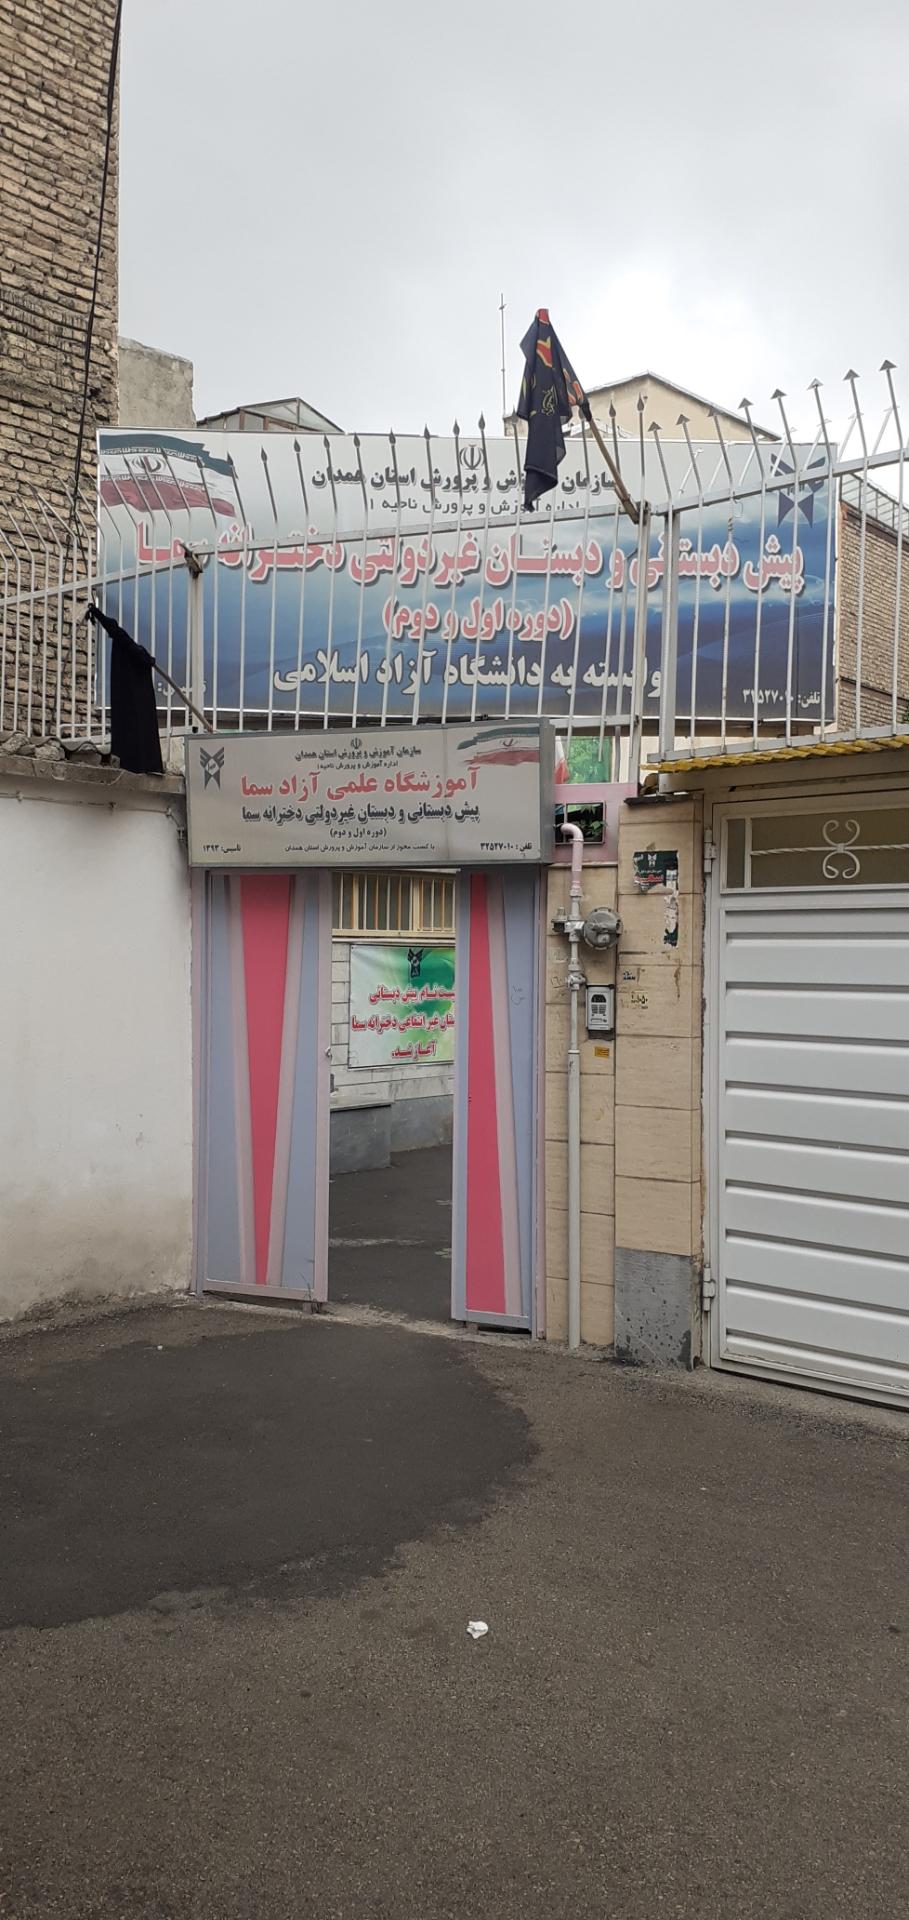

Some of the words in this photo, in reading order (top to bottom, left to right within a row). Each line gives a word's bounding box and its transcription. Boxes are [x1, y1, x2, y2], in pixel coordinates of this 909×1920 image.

[311, 465, 365, 489] همدان
[370, 466, 416, 490] استان
[420, 467, 478, 492] پرورش
[381, 498, 418, 513] ناحیه
[422, 498, 474, 515] پرورش
[478, 502, 486, 514] و
[490, 498, 541, 515] آوزش
[136, 519, 209, 567] ما
[484, 531, 603, 586] دبستان
[605, 547, 626, 589] و
[629, 531, 740, 588] دبستنی
[743, 534, 805, 594] پیش
[441, 608, 459, 640] و
[461, 596, 504, 641] اول
[273, 648, 369, 692] اسلامی
[375, 649, 438, 695] آزاد
[443, 652, 543, 687] دانشگاه
[550, 662, 577, 695] به
[582, 656, 662, 698] وسته
[295, 750, 318, 761] همدان
[318, 749, 337, 760] استان
[338, 748, 362, 760] پرورش
[369, 745, 395, 759] آموزش
[396, 746, 422, 758] سازمان
[335, 762, 356, 770] پرورش
[362, 760, 383, 769] آموزش
[383, 760, 399, 768] اداره
[241, 775, 273, 796] سما
[279, 770, 321, 802] آزاد
[326, 771, 378, 801] علمی
[383, 766, 481, 799] آموزشگاه
[242, 805, 261, 822] سما
[263, 804, 303, 826] دخترانه
[357, 802, 396, 825] دبستان
[397, 808, 405, 824] و
[407, 801, 453, 824] دبستانی
[454, 800, 481, 824] پیش
[353, 827, 365, 838] اول
[304, 843, 320, 852] استان
[320, 843, 341, 852] پرورش
[346, 842, 367, 852] آموزش
[368, 843, 389, 852] سازمان
[351, 1014, 367, 1031] سما
